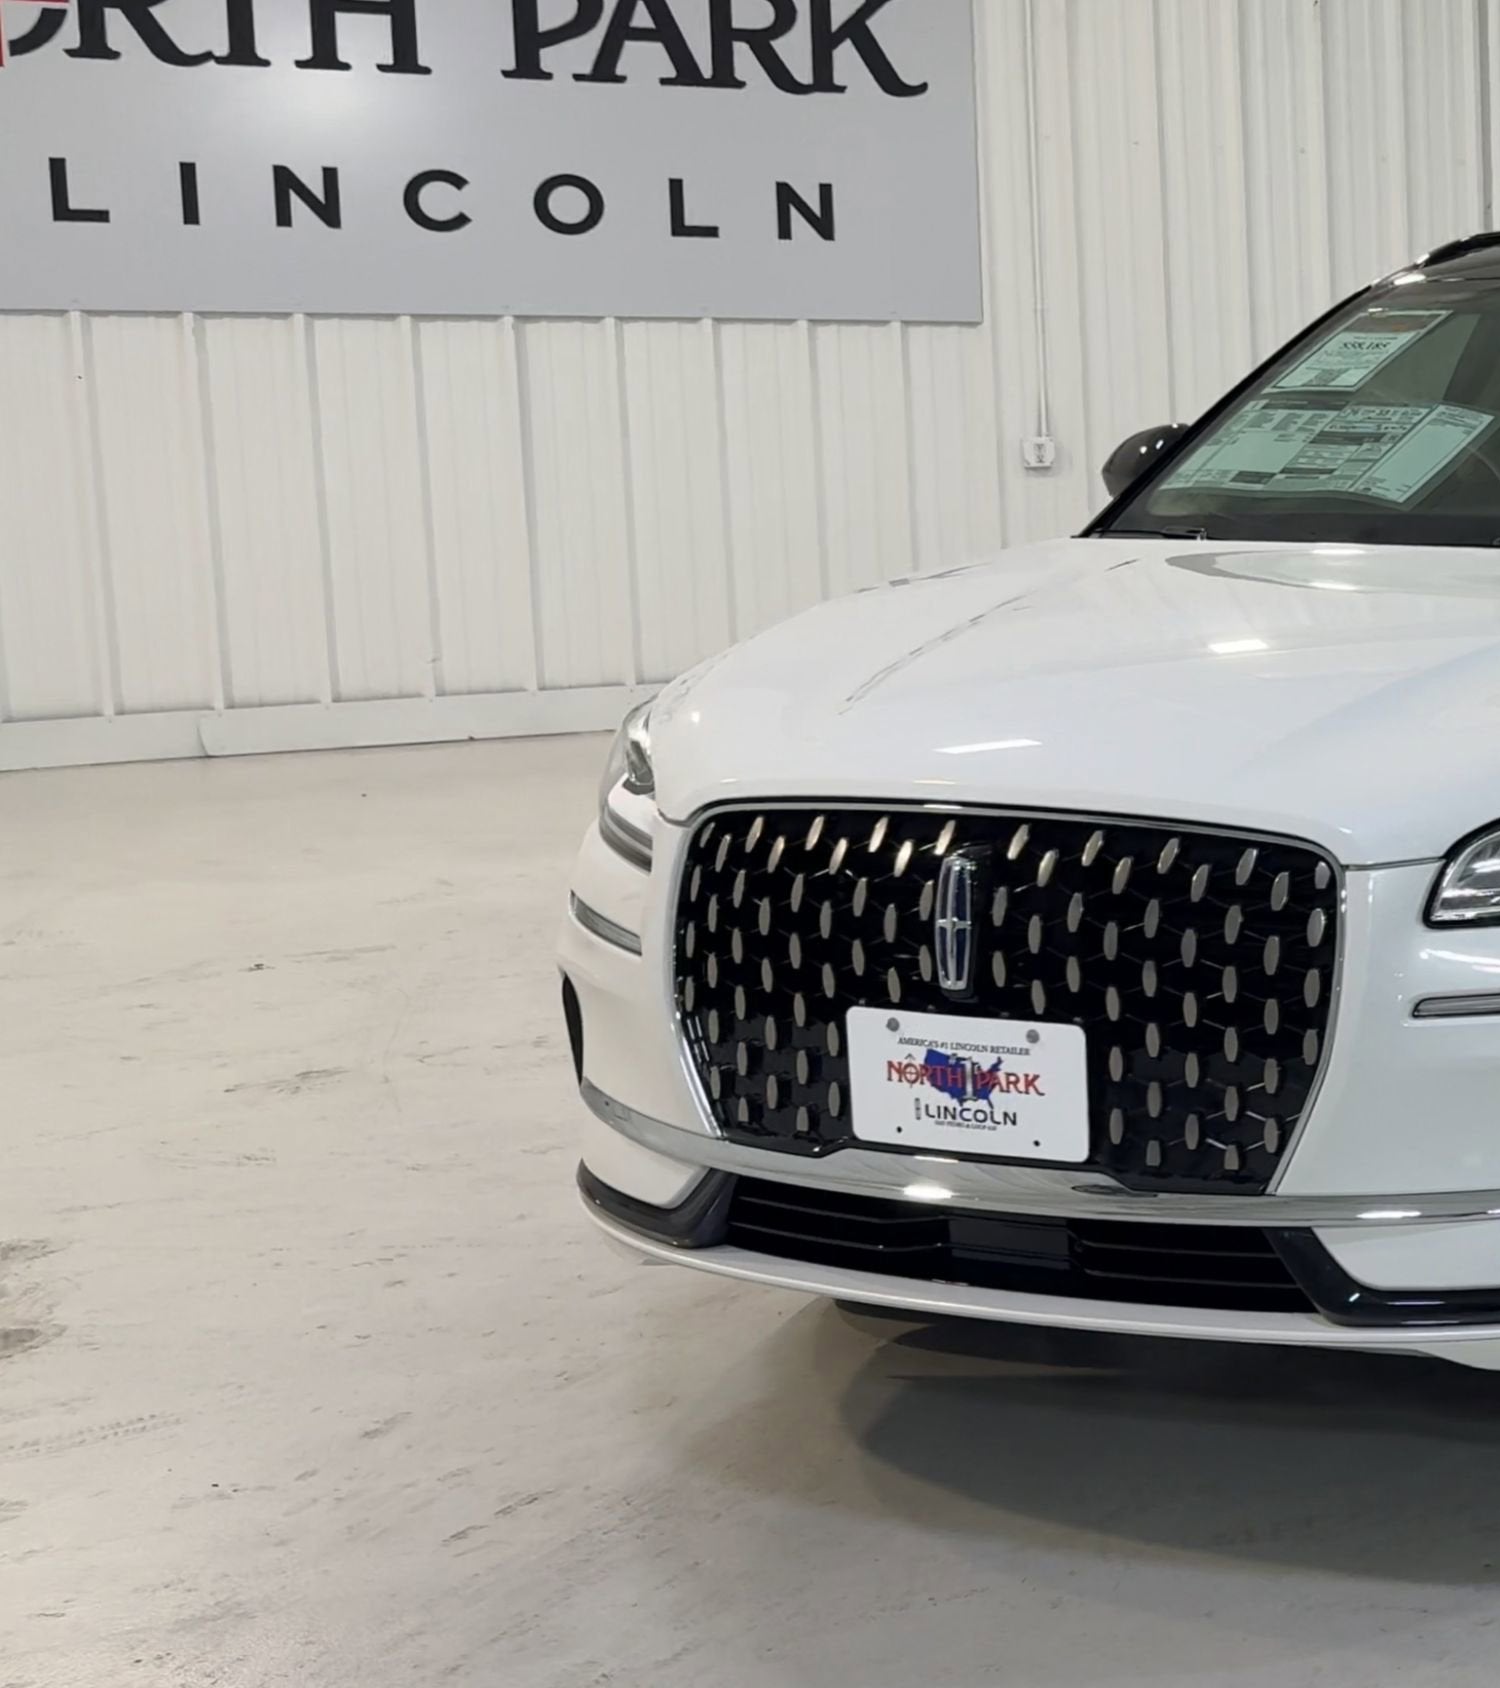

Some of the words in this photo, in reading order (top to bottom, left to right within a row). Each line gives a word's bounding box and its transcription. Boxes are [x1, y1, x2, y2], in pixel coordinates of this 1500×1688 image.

[499, 0, 929, 97] PARK
[48, 156, 836, 241] LINCOLN
[950, 1042, 988, 1053] LINCOLN
[990, 1045, 1030, 1056] RETAILER
[886, 1060, 963, 1088] NORTH
[975, 1070, 1045, 1096] PARK
[925, 1104, 1017, 1126] LINCOLN
